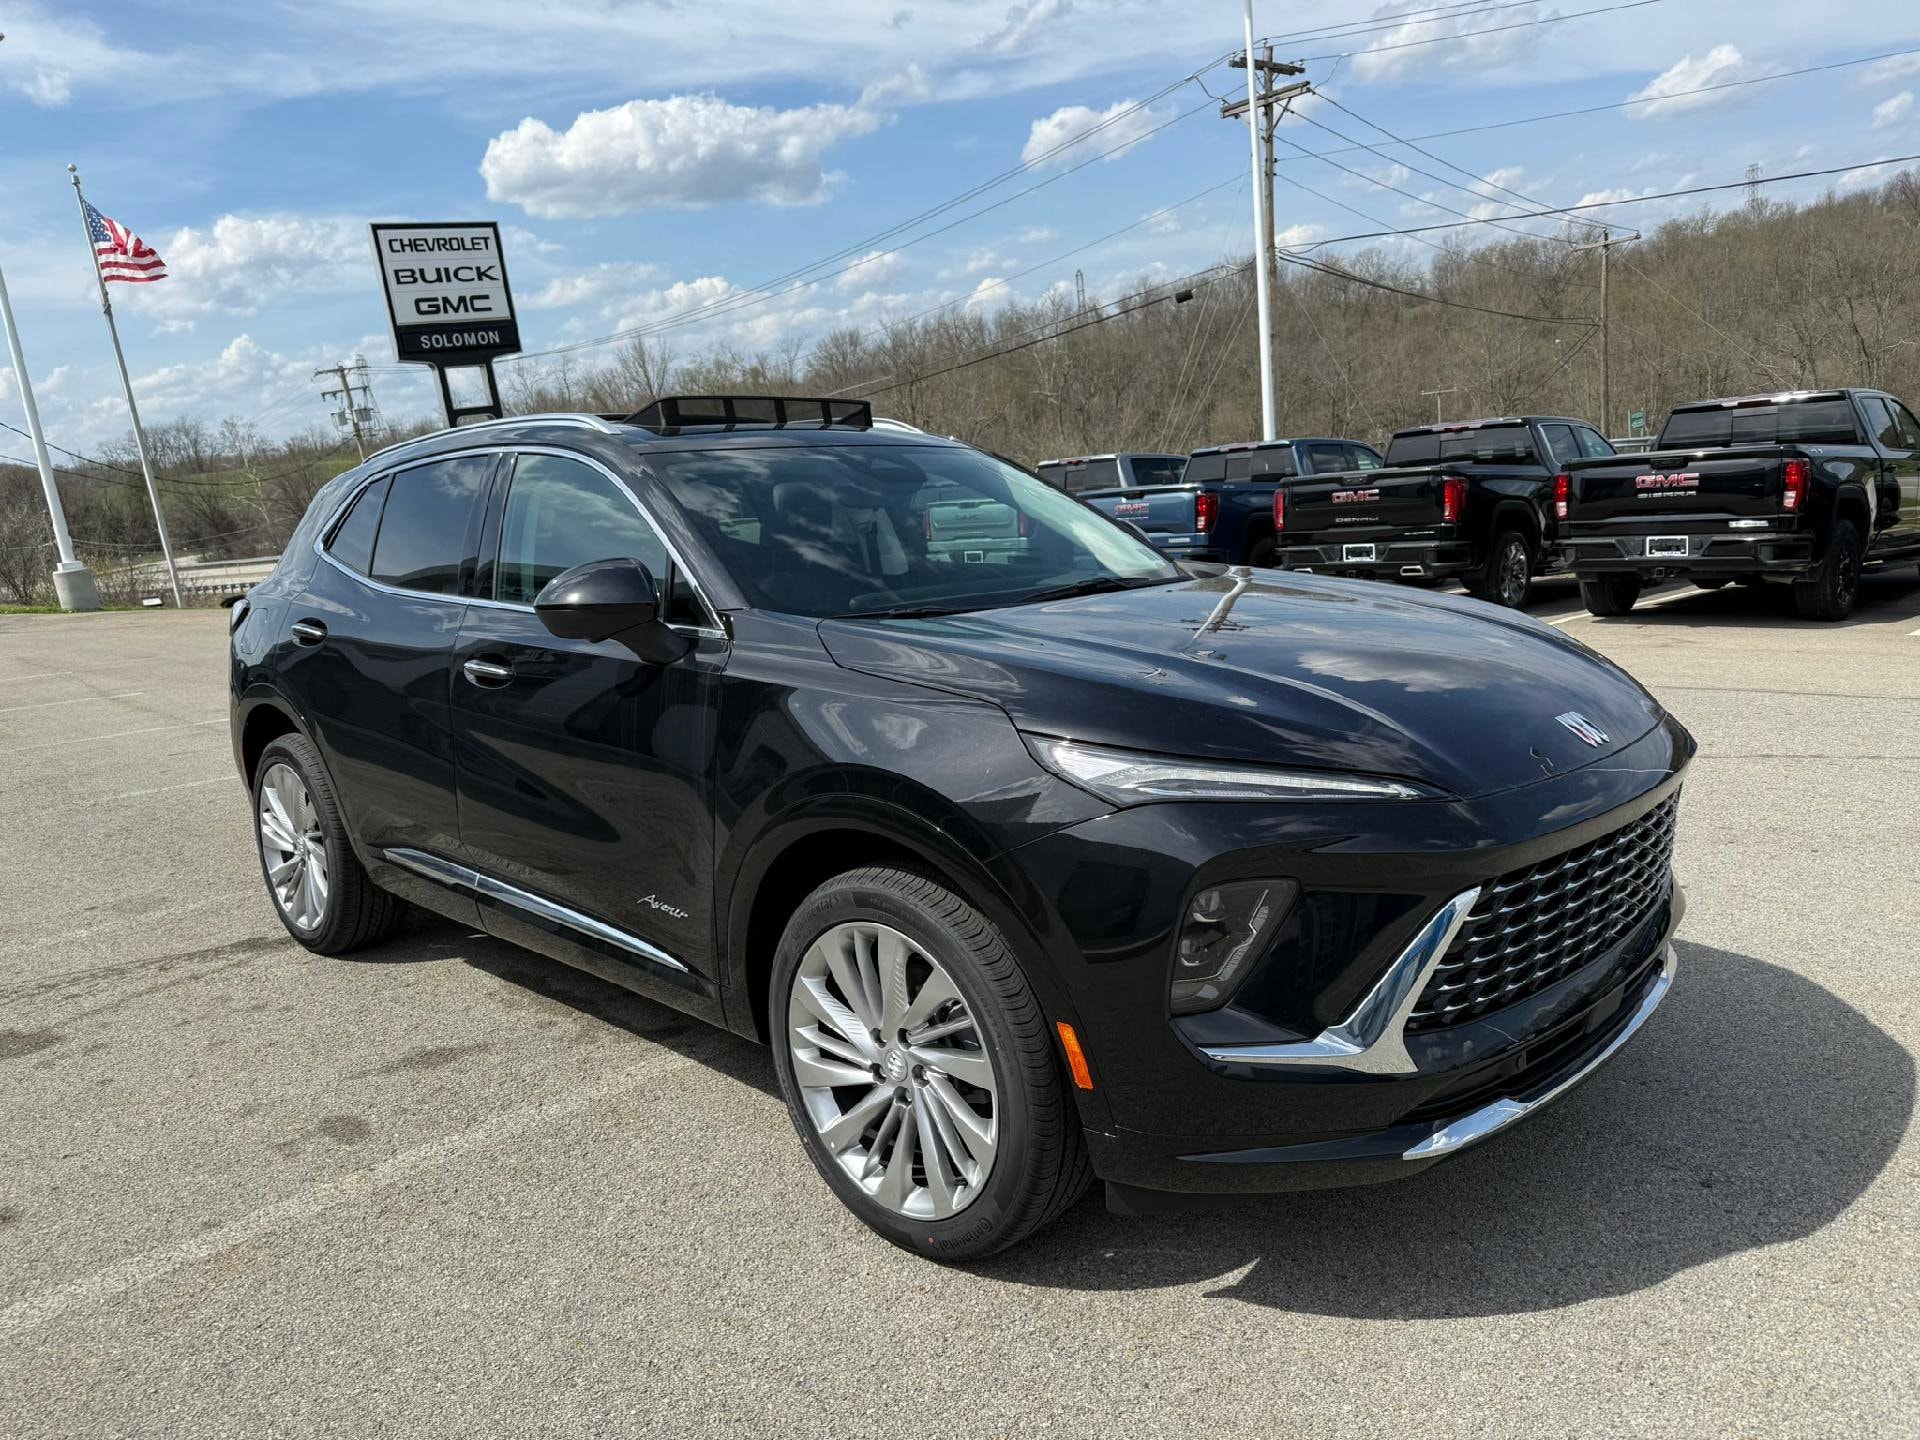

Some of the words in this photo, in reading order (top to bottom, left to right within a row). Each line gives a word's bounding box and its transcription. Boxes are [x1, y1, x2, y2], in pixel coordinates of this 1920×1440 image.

[388, 236, 490, 253] CHEVROLET
[393, 265, 500, 285] BUICK
[414, 294, 492, 315] GMC
[420, 330, 500, 349] SOLOMON
[1635, 472, 1700, 489] GMC
[1331, 488, 1380, 504] GMC
